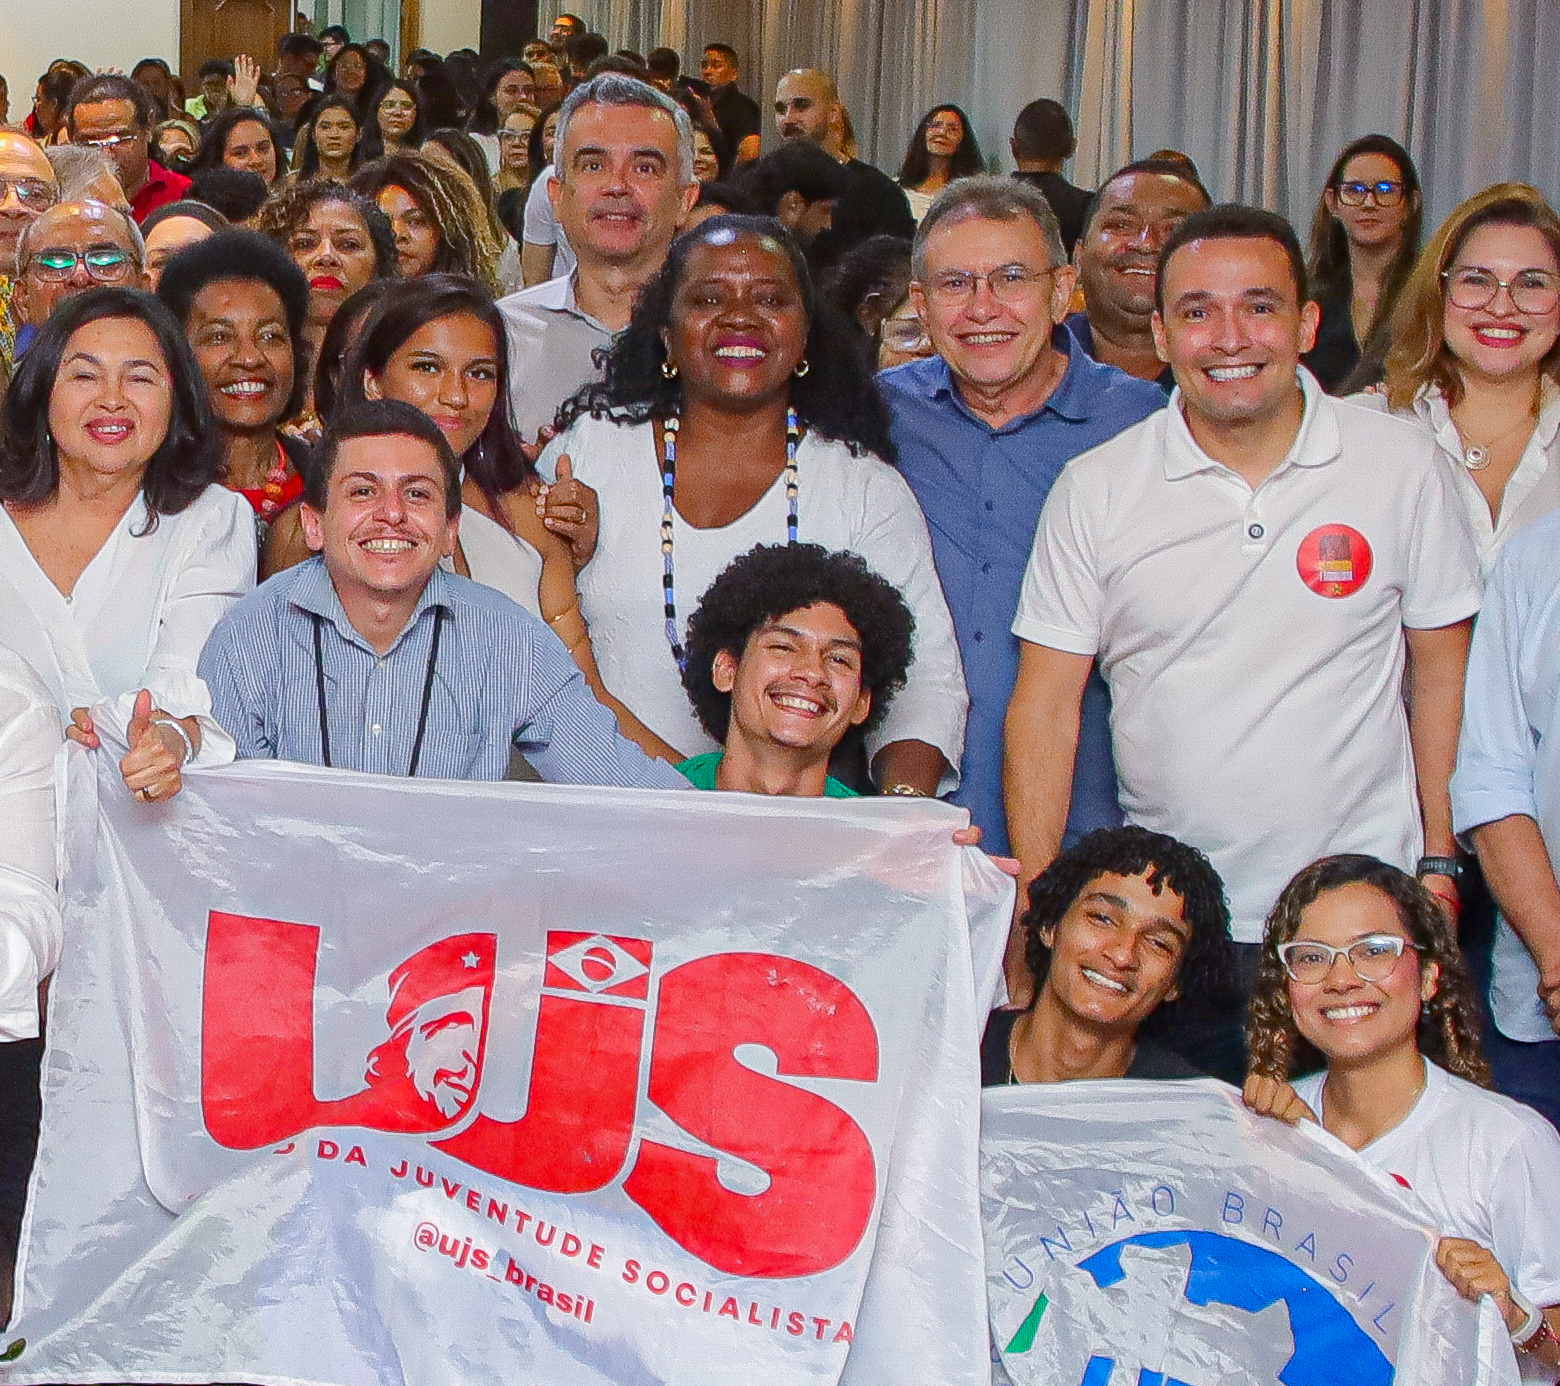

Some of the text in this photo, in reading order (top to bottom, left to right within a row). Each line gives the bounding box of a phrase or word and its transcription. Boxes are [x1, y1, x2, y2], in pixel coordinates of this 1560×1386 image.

[317, 1139, 855, 1346] DA JUVENTUDE SOCIALISTA
[414, 1221, 597, 1326] @ujs_brasil
[1002, 1184, 1177, 1290] UNIÃO
